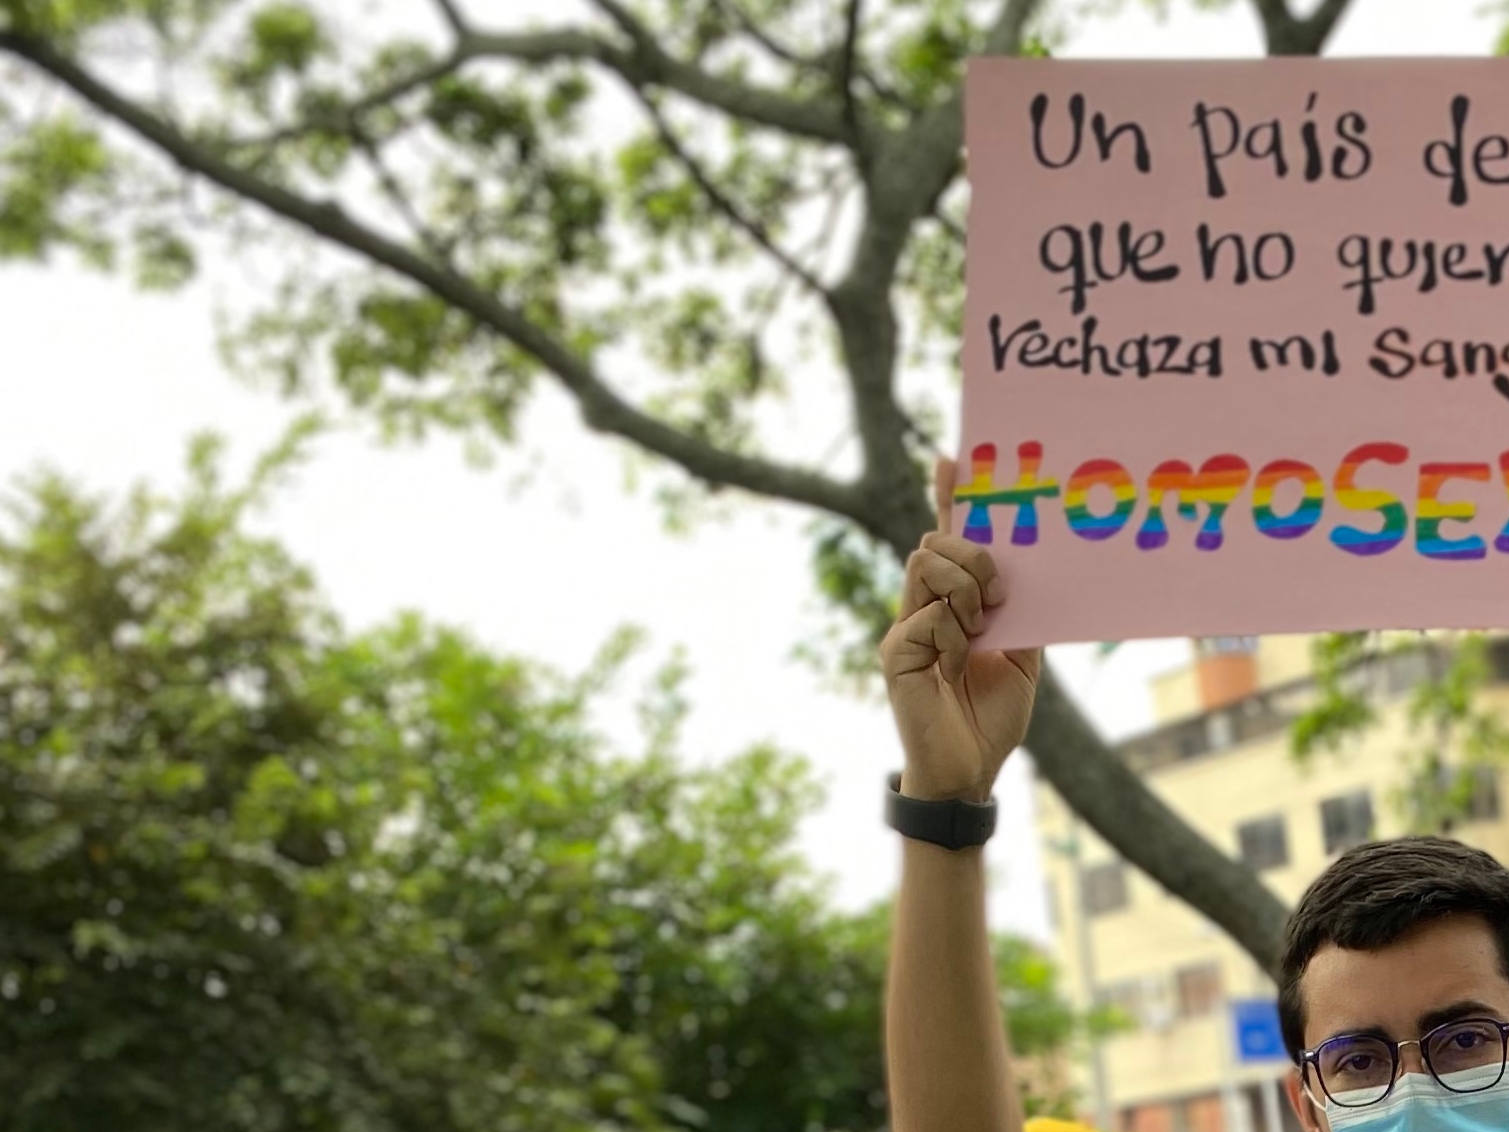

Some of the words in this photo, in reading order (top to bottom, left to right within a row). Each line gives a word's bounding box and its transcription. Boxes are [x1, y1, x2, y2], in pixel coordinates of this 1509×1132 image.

[1029, 92, 1151, 174] Un
[1192, 92, 1373, 199] país
[1039, 221, 1180, 315] que
[1197, 222, 1296, 285] no
[988, 314, 1223, 378] rechaza
[1250, 329, 1341, 376] mi
